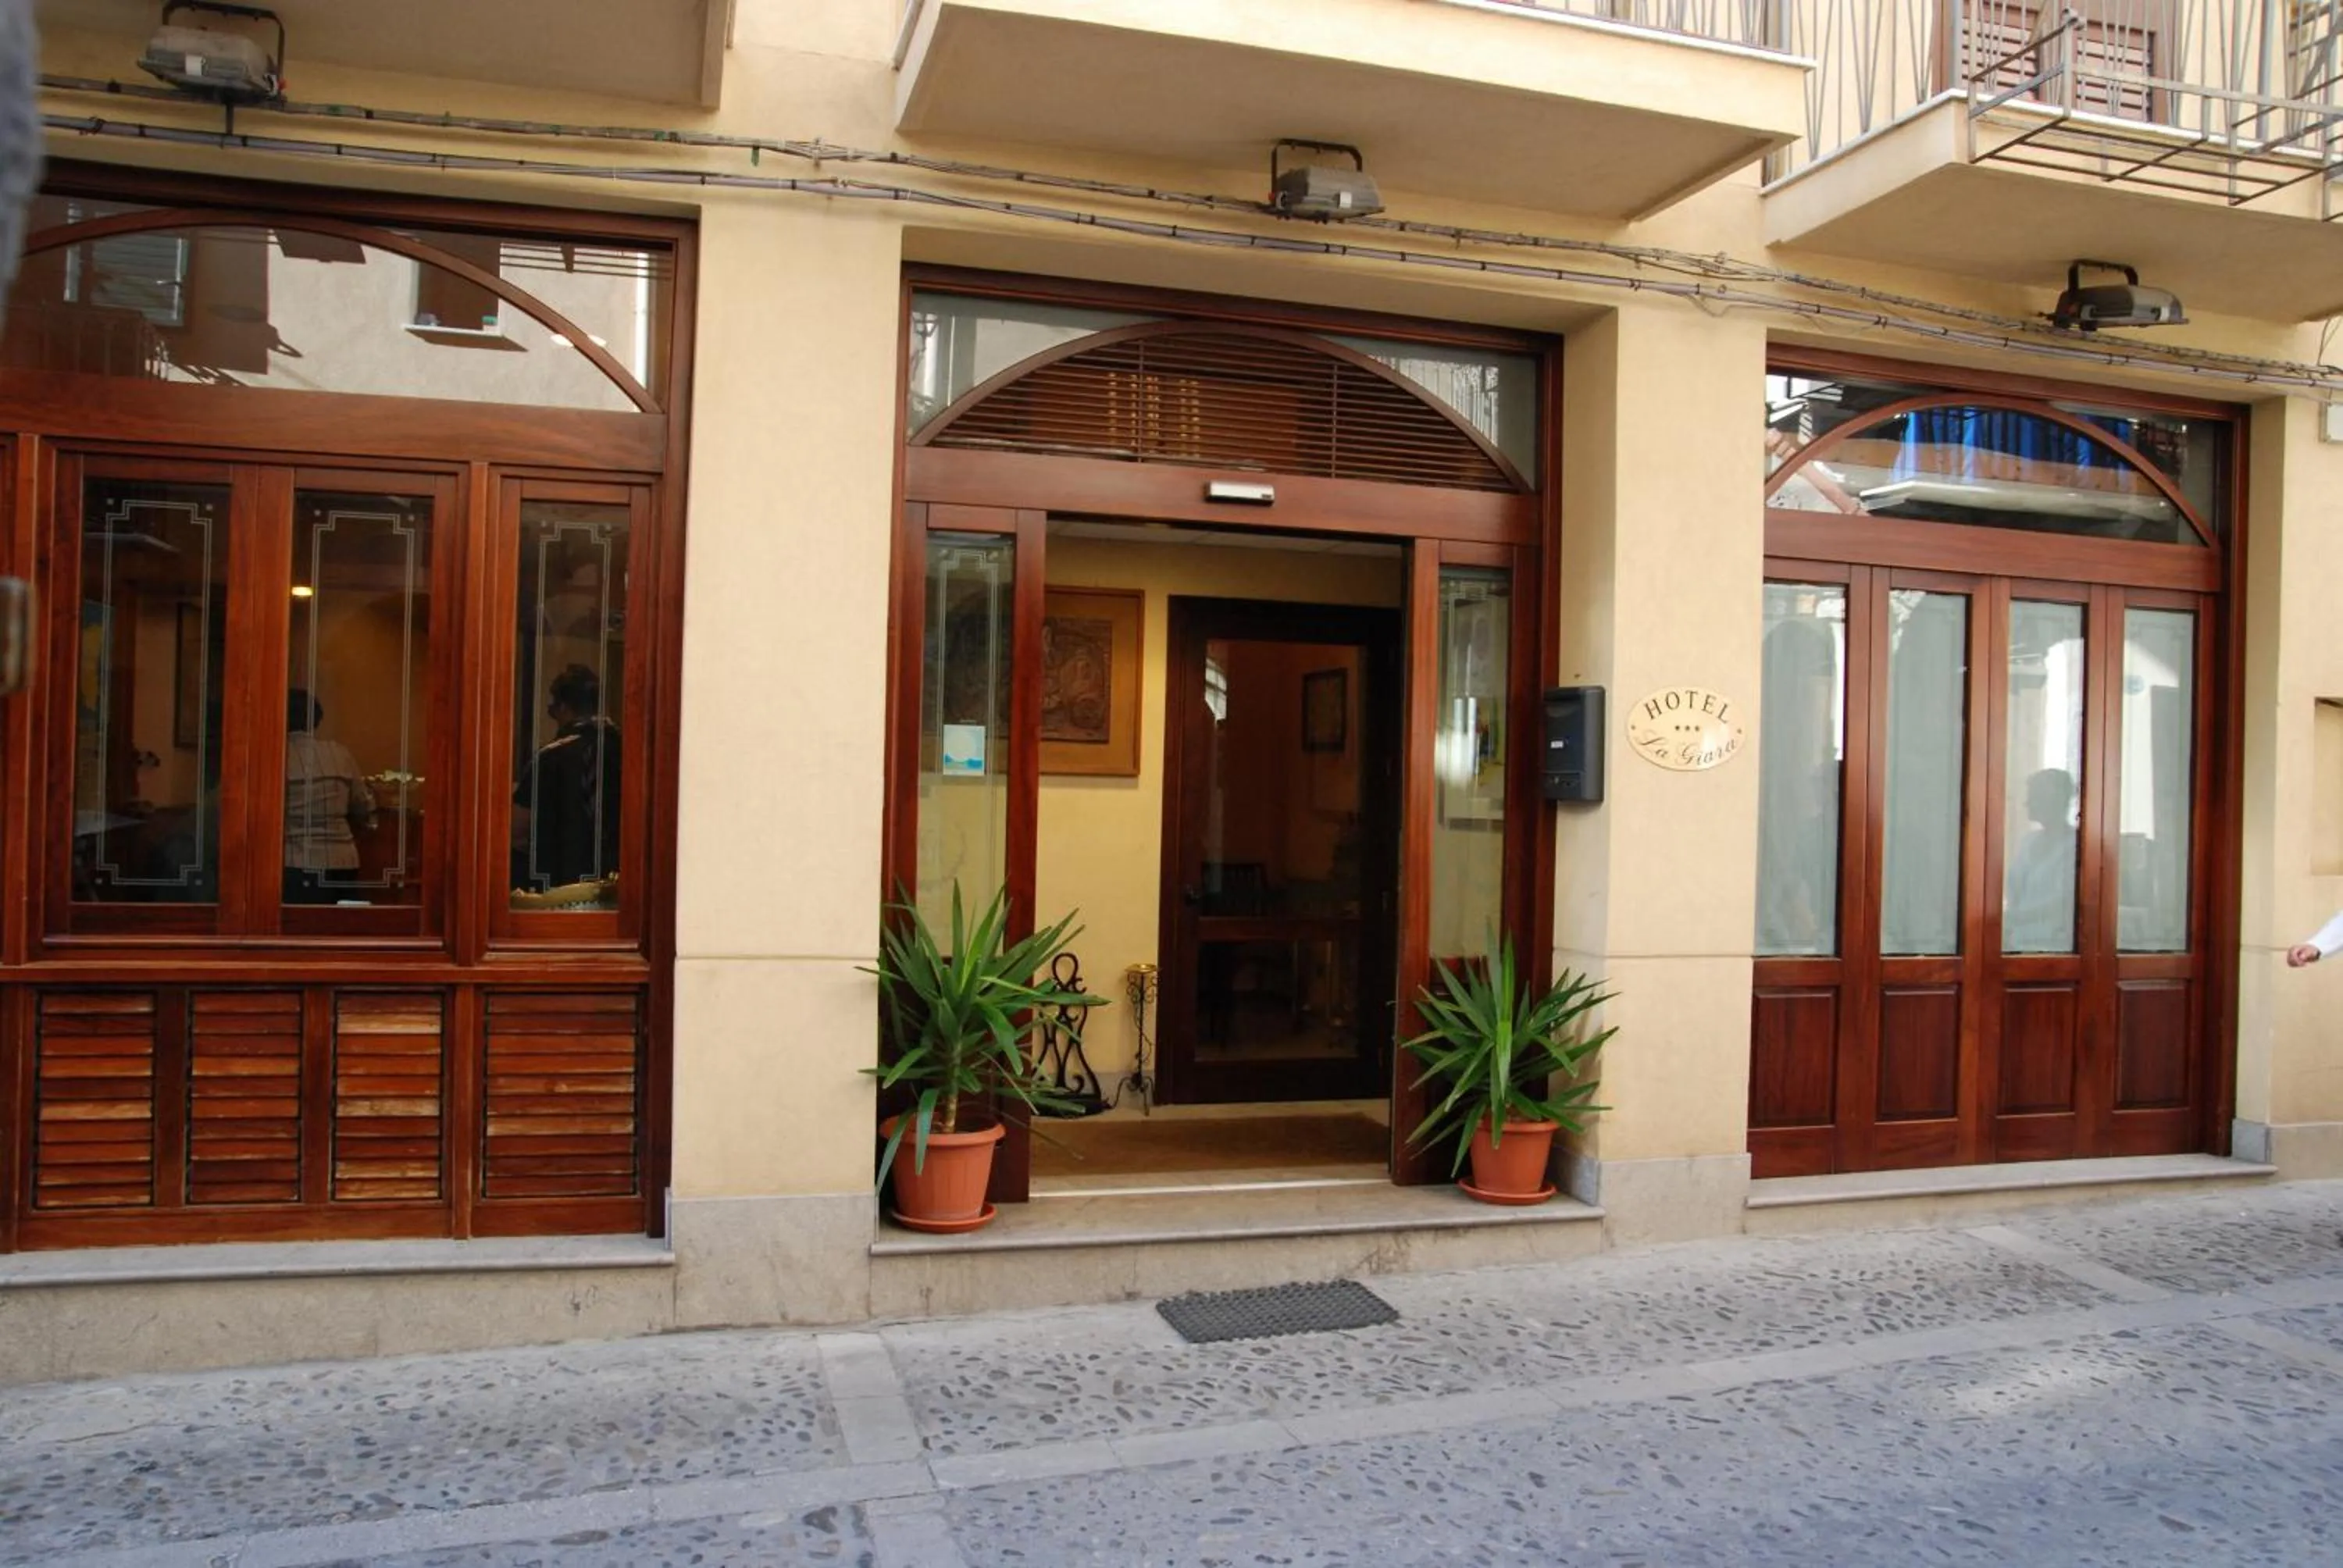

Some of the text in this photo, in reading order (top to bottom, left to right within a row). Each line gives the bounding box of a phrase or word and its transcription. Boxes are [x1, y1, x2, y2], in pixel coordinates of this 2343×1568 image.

[1643, 690, 1730, 725] HOTEL
[1634, 729, 1738, 765] La Giara
